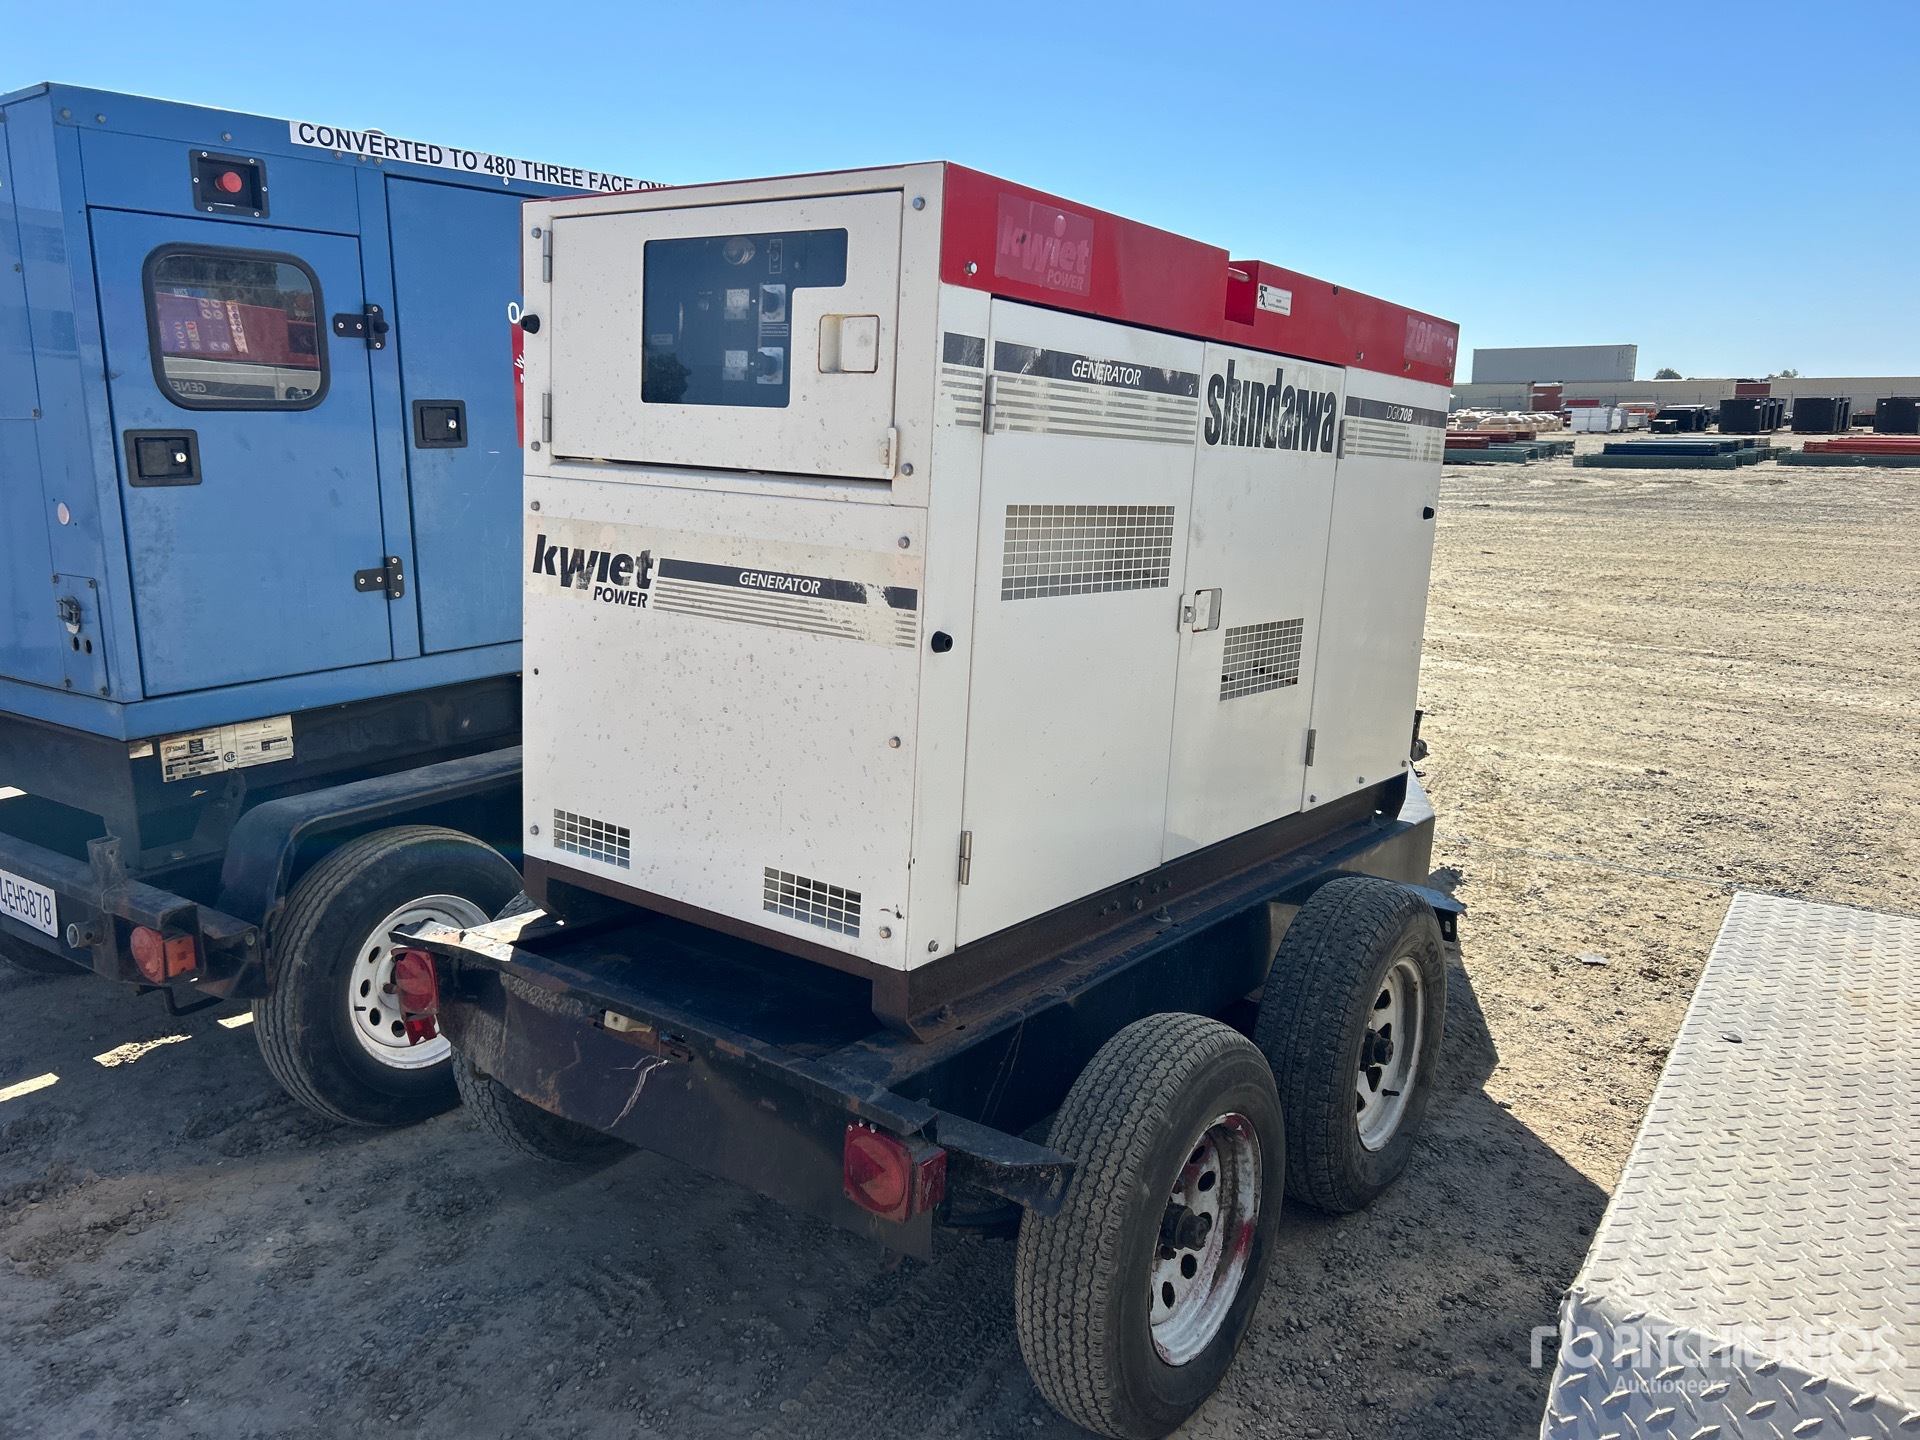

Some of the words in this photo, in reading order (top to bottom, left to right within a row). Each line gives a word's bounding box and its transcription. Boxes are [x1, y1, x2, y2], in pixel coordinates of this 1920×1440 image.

[298, 122, 443, 165] CONVERTED
[449, 148, 477, 171] TO
[484, 156, 516, 177] 480
[521, 160, 583, 187] THREE
[589, 172, 633, 192] FACE
[1000, 214, 1090, 275] kwiet
[1047, 268, 1084, 291] POWER
[1071, 359, 1142, 385] GENERATOR
[1204, 359, 1337, 453] shindaiwa
[533, 533, 654, 591] kwiet
[739, 571, 821, 595] GENERATOR
[593, 585, 648, 609] POWER
